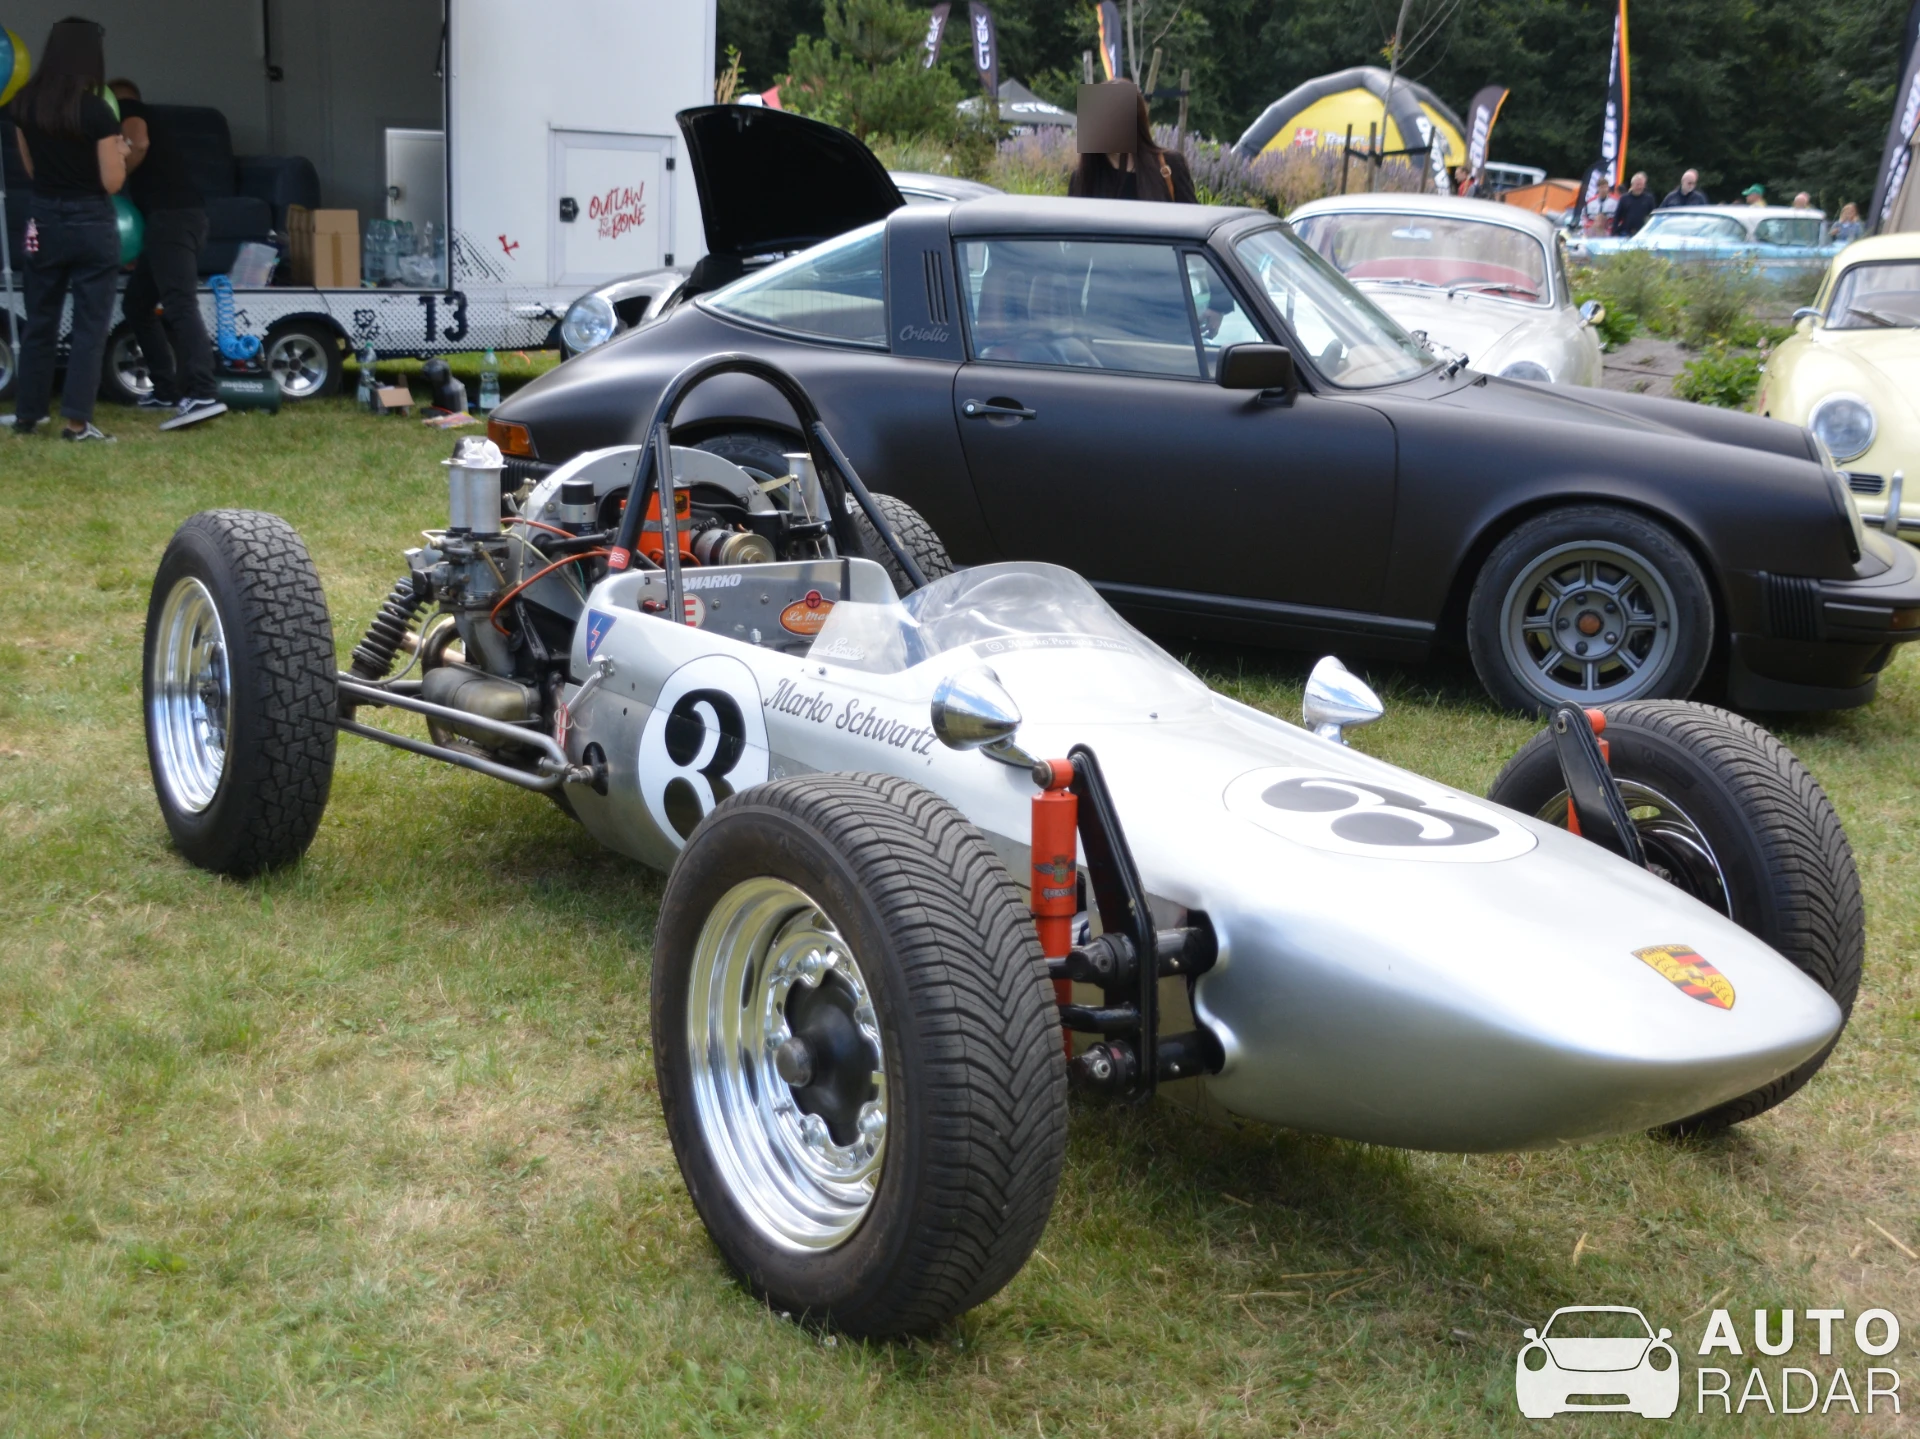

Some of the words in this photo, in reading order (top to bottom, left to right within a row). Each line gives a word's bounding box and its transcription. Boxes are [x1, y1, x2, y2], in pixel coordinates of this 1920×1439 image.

[975, 15, 991, 70] CTEK
[1011, 102, 1064, 116] CTEK
[589, 181, 644, 220] OUTLAW
[612, 204, 646, 239] BONE
[419, 291, 468, 342] 13
[900, 325, 949, 343] Criollo
[221, 380, 264, 390] metabo
[785, 611, 803, 621] Le
[764, 677, 833, 724] Marko
[836, 698, 938, 756] Schwartz
[1261, 777, 1498, 846] 3
